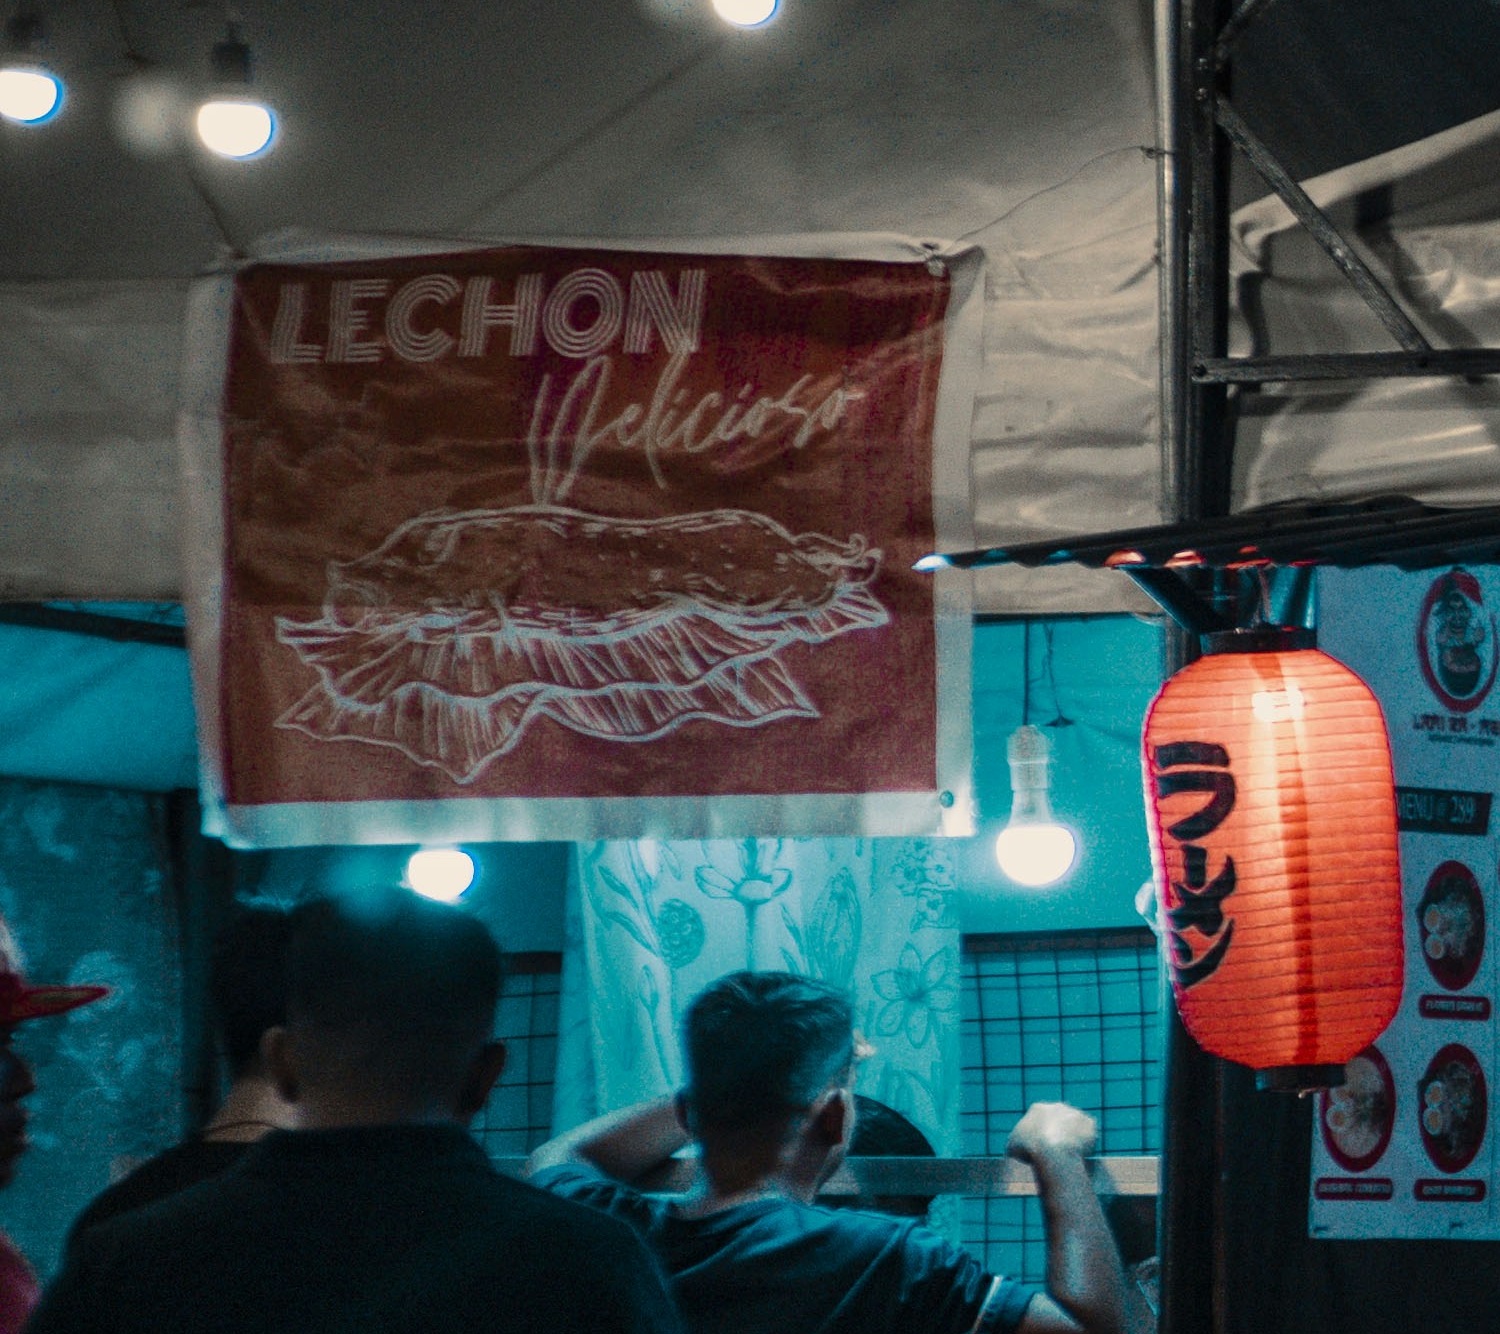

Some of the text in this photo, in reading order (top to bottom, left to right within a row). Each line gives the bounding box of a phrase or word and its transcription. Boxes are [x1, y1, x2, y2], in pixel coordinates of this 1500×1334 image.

[270, 268, 708, 364] LECHON
[1154, 740, 1237, 993] ラーメン
